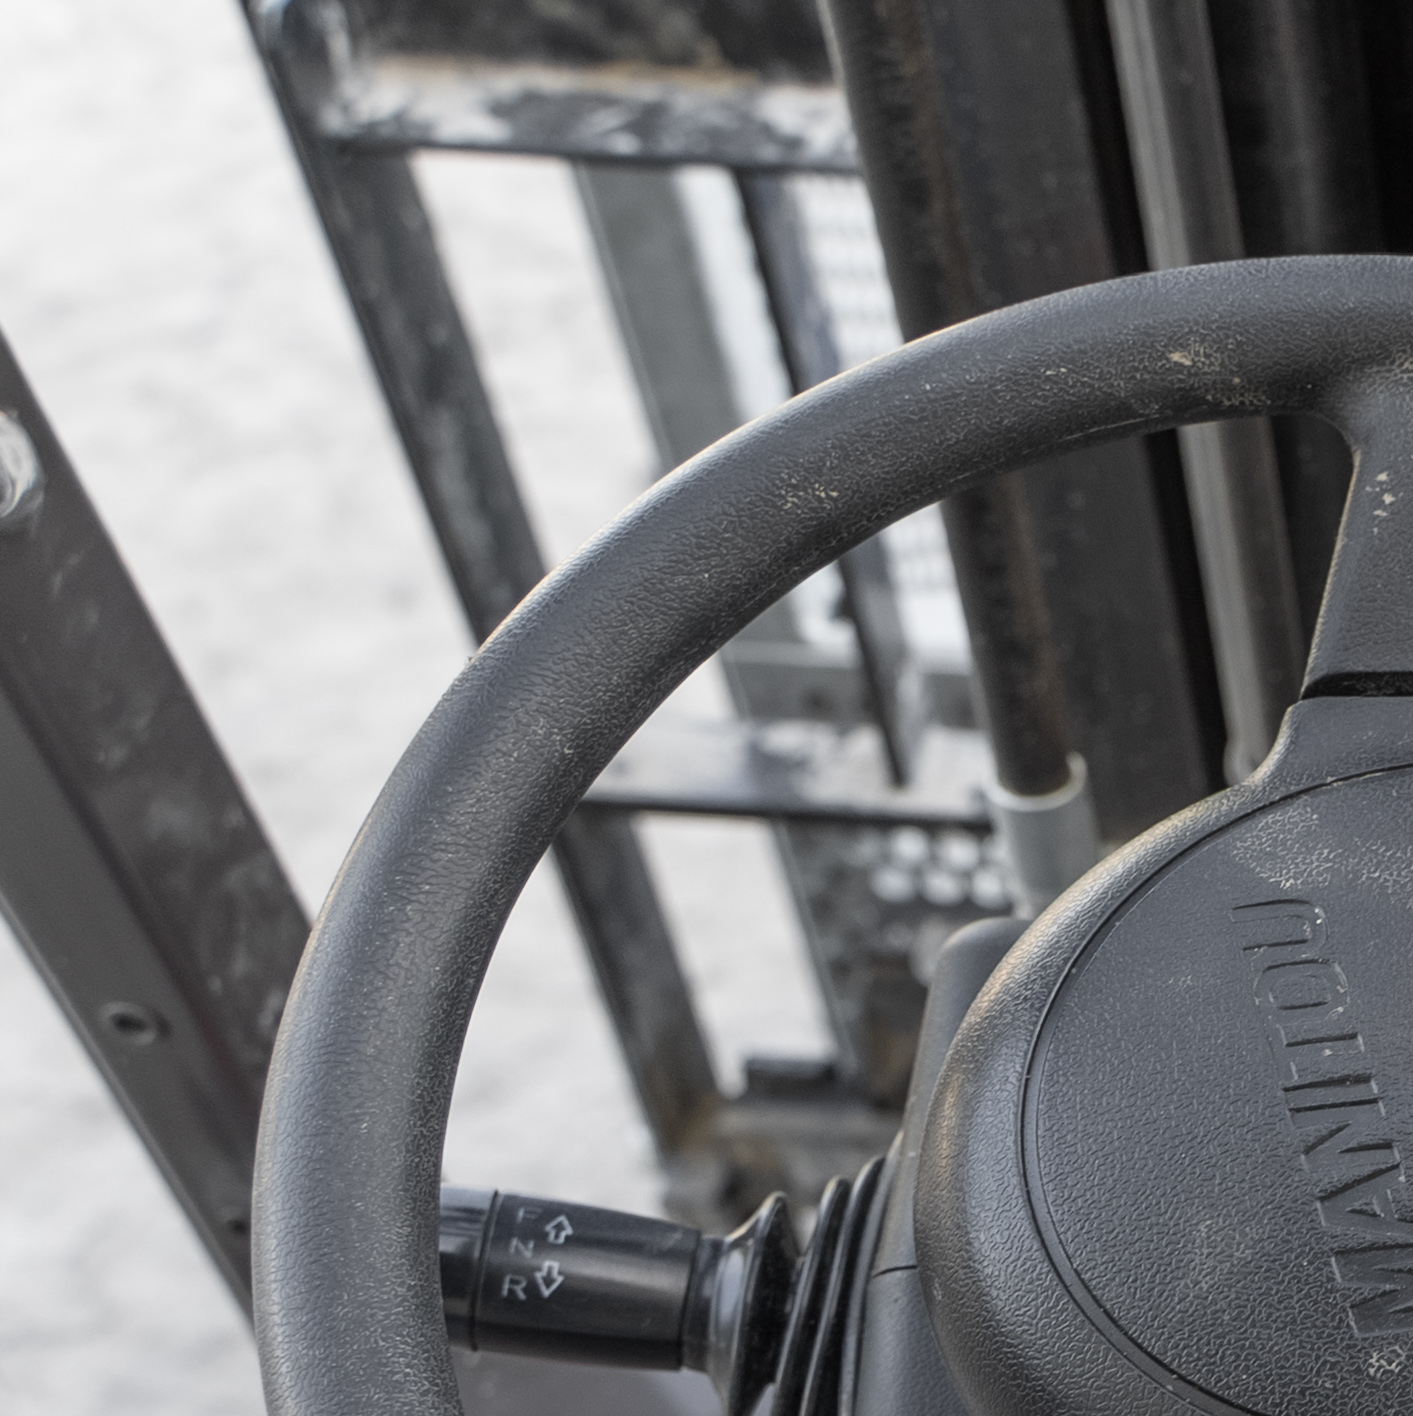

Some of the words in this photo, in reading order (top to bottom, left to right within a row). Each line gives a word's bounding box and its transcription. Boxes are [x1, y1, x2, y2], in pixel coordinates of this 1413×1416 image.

[516, 1206, 543, 1225] F
[508, 1236, 535, 1260] N
[501, 1273, 528, 1300] R
